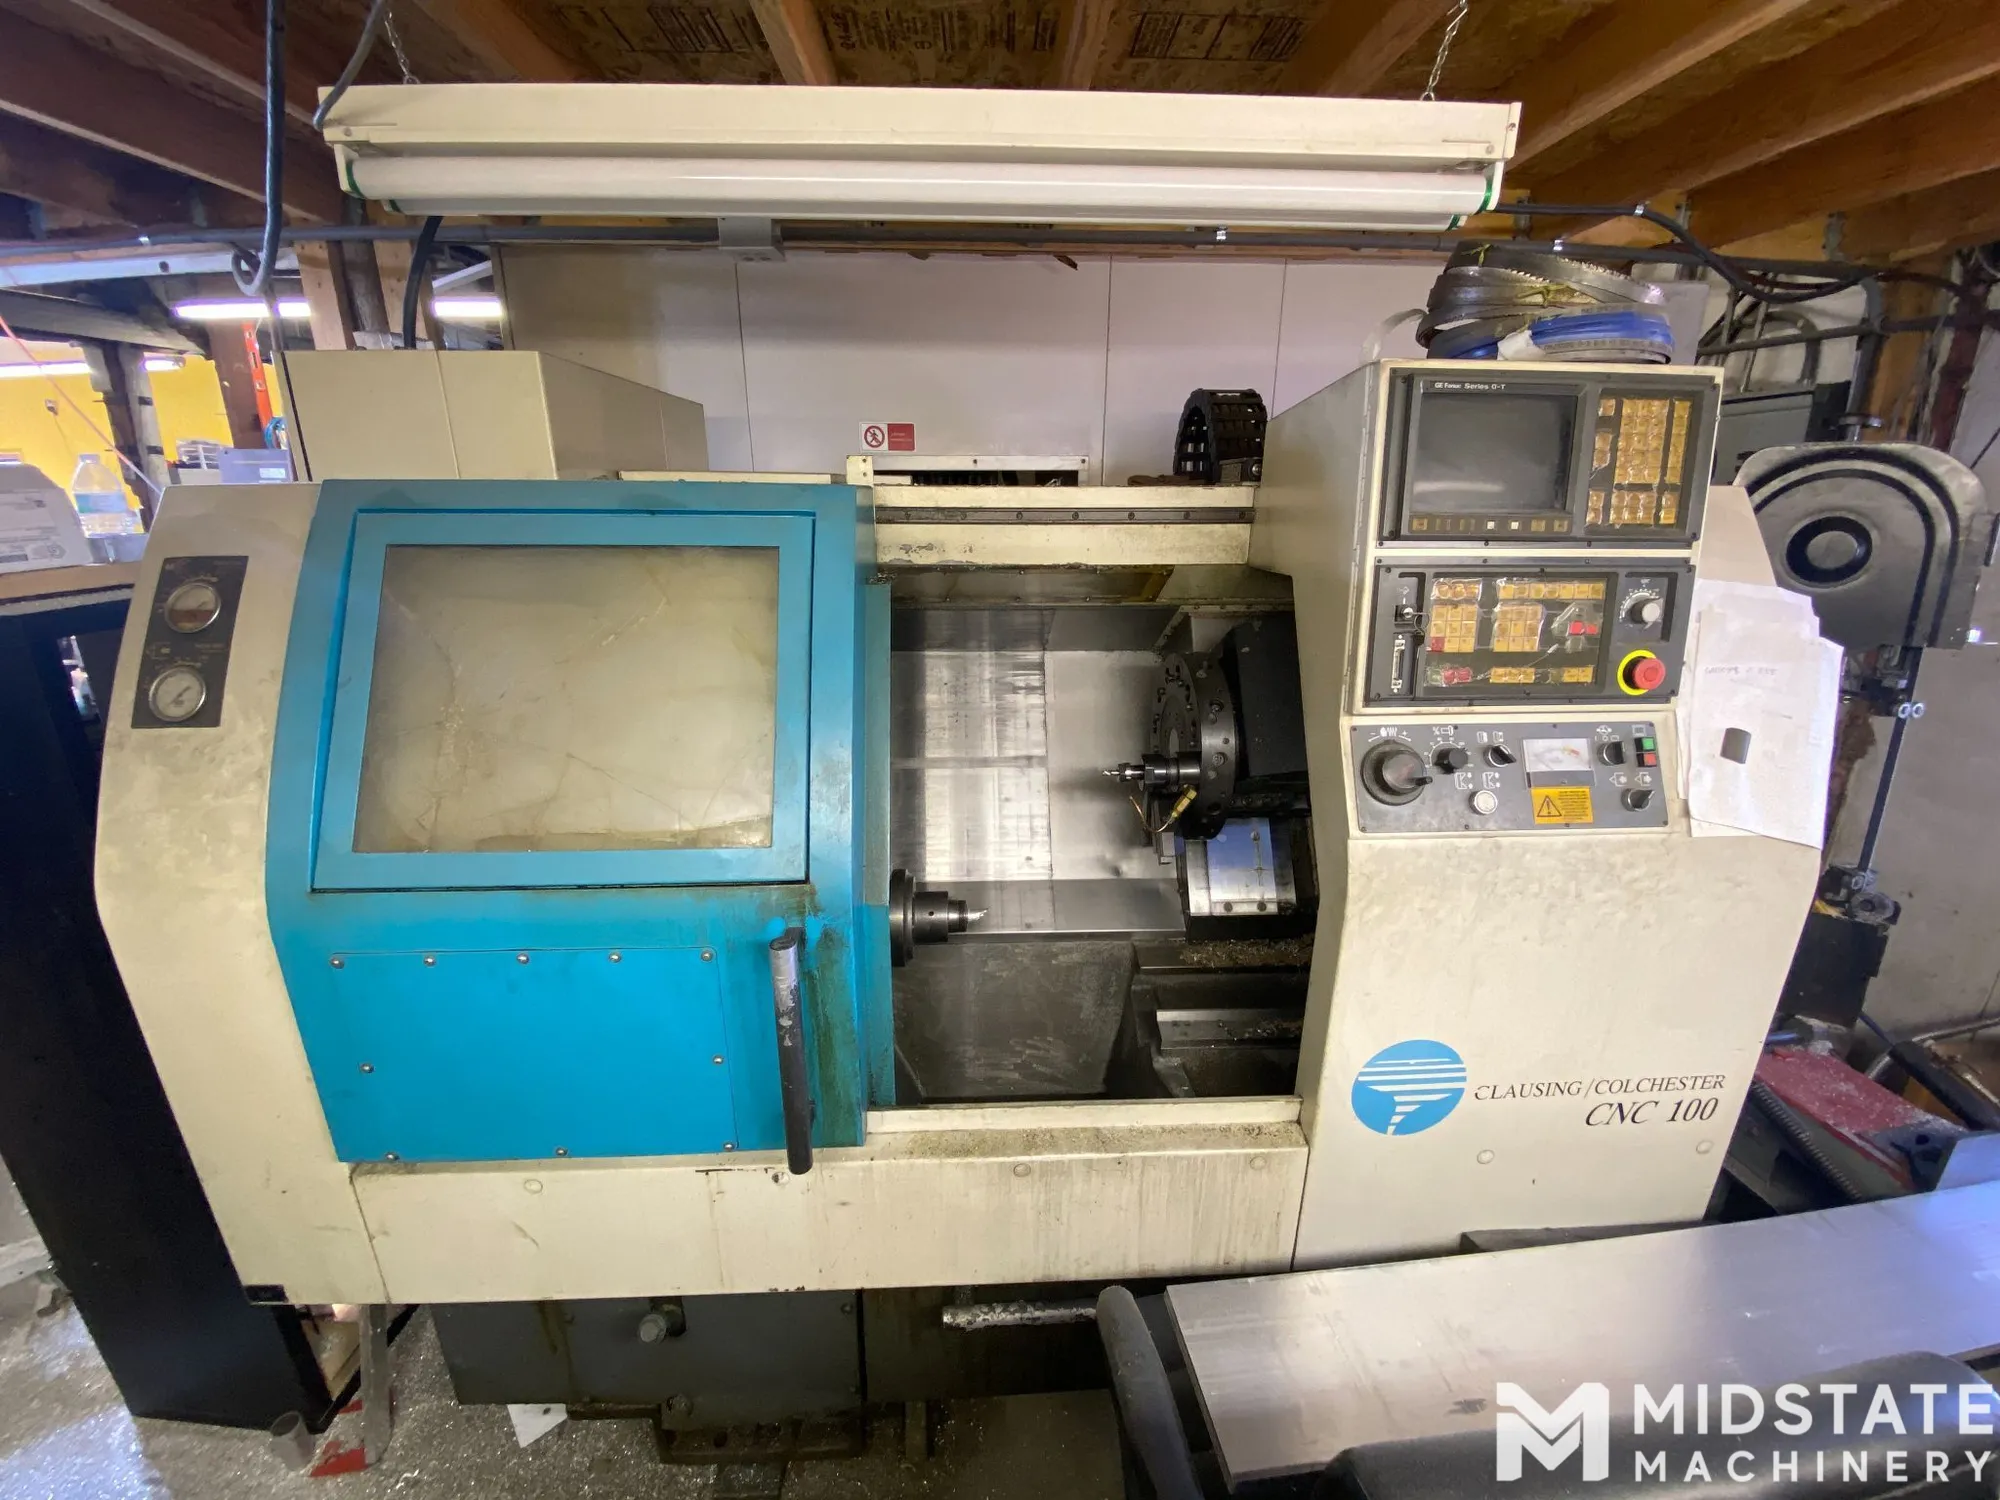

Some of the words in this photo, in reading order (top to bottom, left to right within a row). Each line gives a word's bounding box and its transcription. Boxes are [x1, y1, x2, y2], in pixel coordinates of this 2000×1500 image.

[1464, 382, 1489, 390] Series
[1585, 1100, 1659, 1127] CNC
[1666, 1097, 1719, 1123] 100
